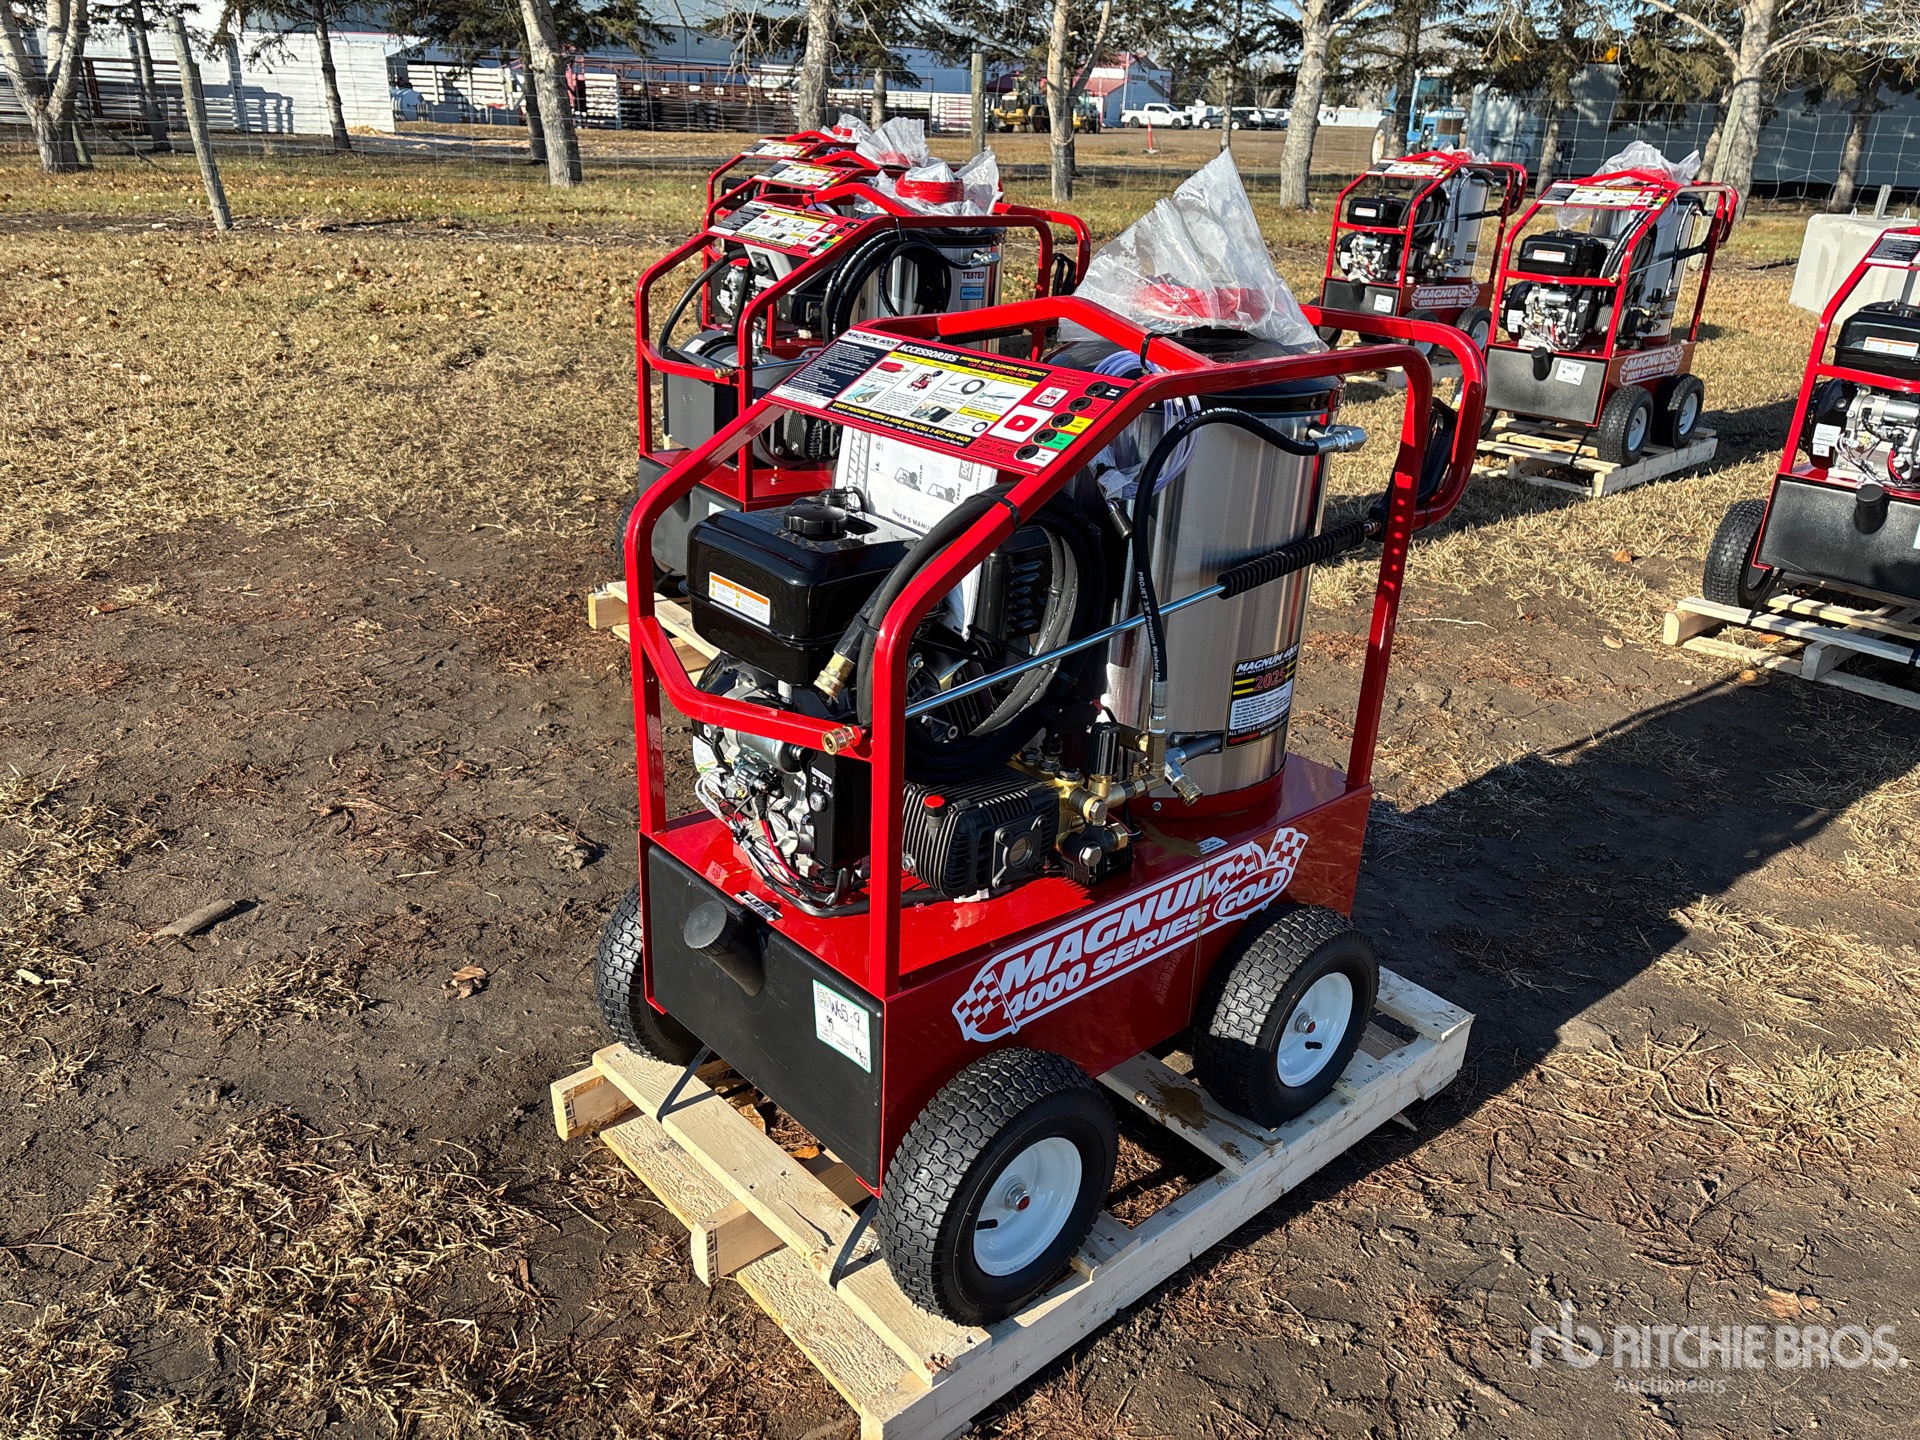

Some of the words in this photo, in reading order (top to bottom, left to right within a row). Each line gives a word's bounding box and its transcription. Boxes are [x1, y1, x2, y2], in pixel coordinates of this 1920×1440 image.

[962, 271, 984, 279] TESTED
[1418, 288, 1462, 298] MAGNUM
[897, 344, 959, 362] ACCESSORIES
[1626, 350, 1669, 370] MAGNUM
[959, 355, 982, 364] IMPROVE
[994, 362, 1019, 371] CLEANING
[1018, 367, 1048, 377] EFFICIENCY
[847, 406, 870, 415] MACHINE
[996, 447, 1012, 457] 4pm
[892, 508, 911, 524] OWNER'S
[1138, 572, 1148, 599] PROJET
[1147, 616, 1156, 644] Pressure
[1236, 652, 1284, 672] MAGNUM
[1254, 666, 1286, 691] 2025
[1238, 726, 1252, 735] PARTS
[743, 893, 775, 918] FUEL
[1001, 860, 1243, 993] MAGNUM
[1004, 964, 1088, 1019] 4000
[1090, 904, 1211, 978] SERIES
[1218, 870, 1285, 914] GOLD
